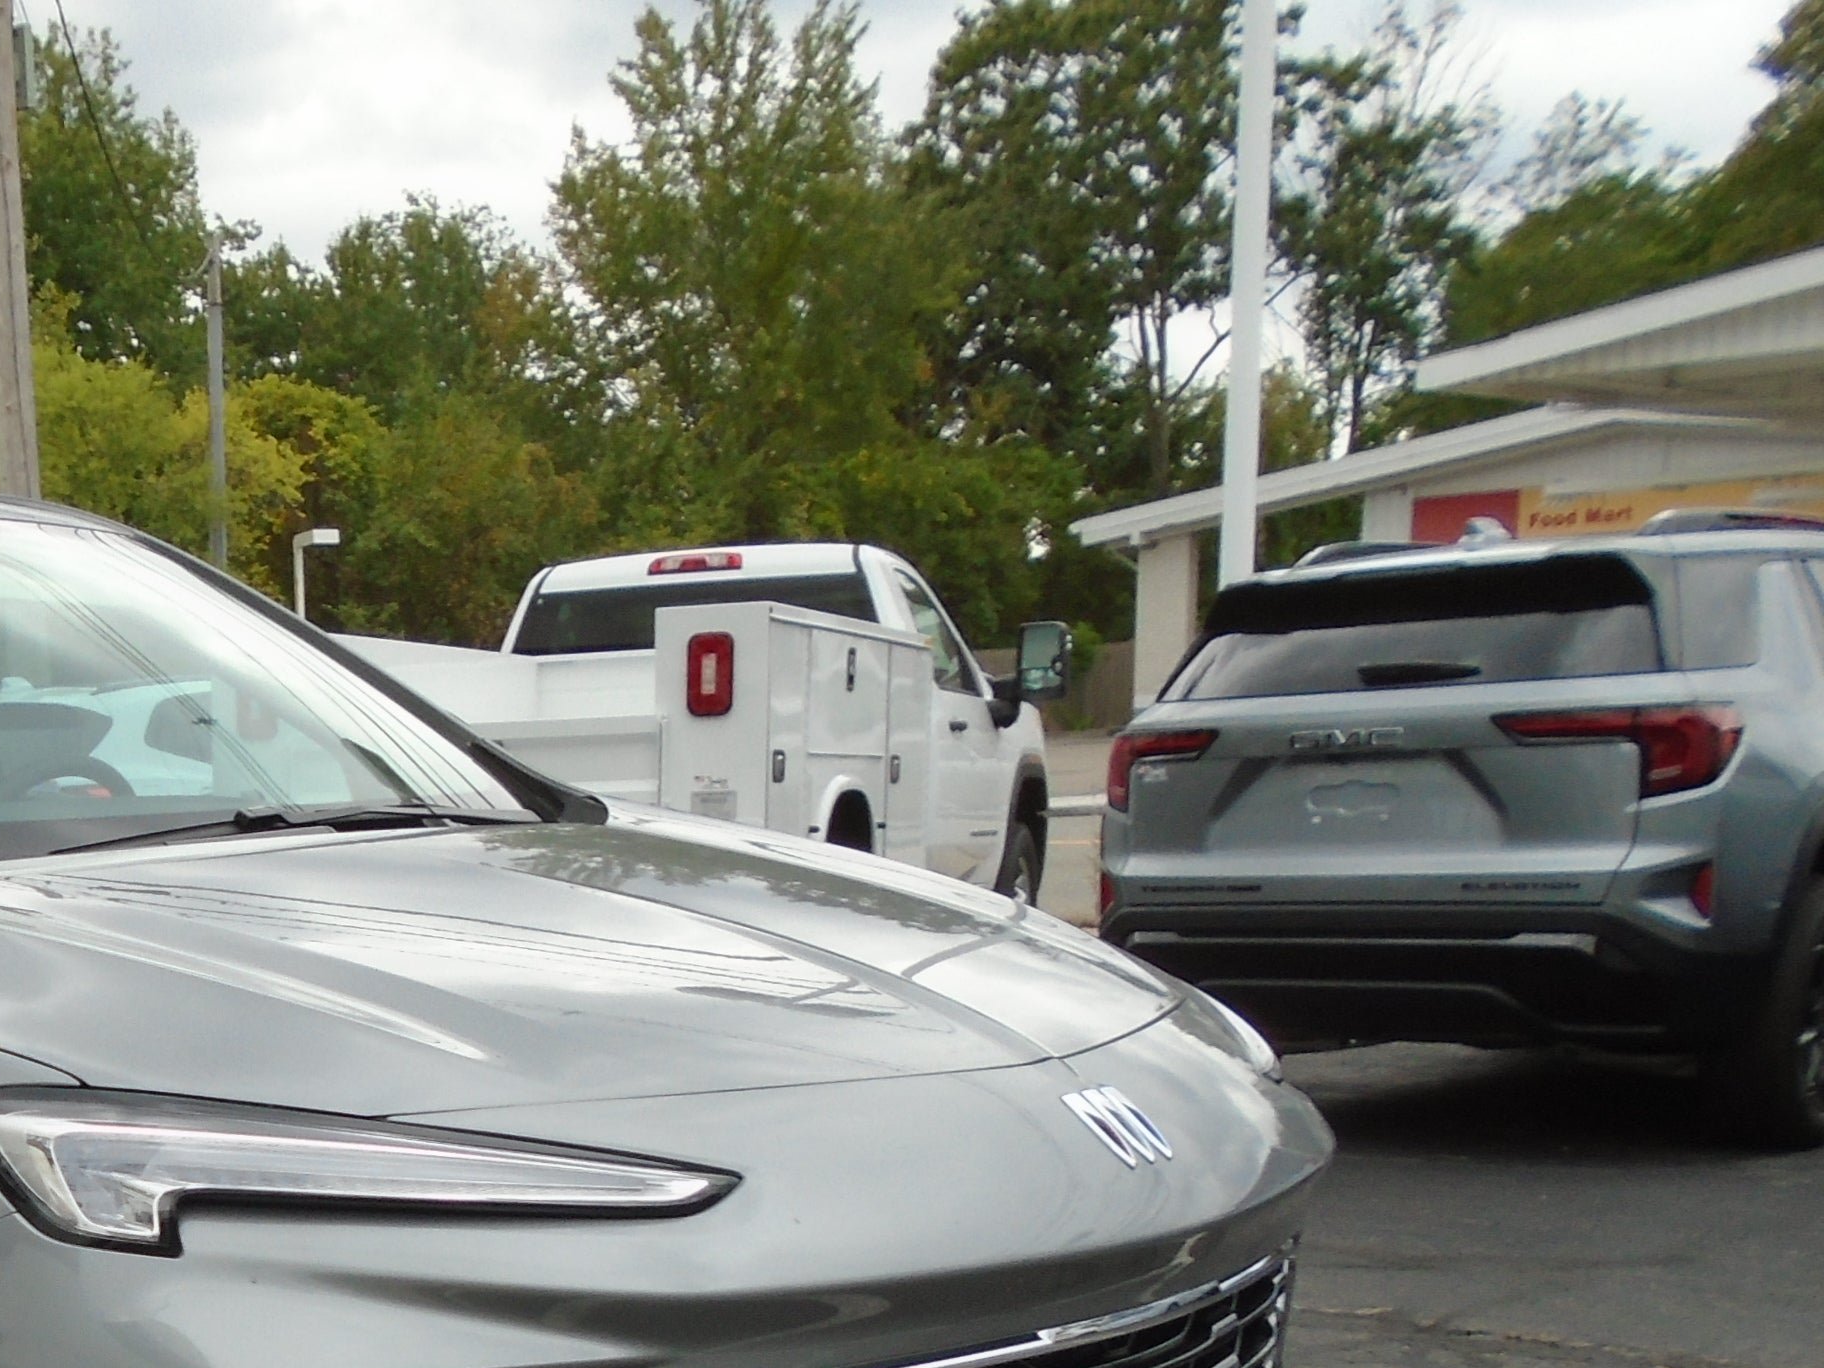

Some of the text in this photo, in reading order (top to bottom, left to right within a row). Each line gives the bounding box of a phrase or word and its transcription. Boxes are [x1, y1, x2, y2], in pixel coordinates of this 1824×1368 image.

[1529, 504, 1632, 529] Food Mart
[1288, 727, 1405, 749] GMC
